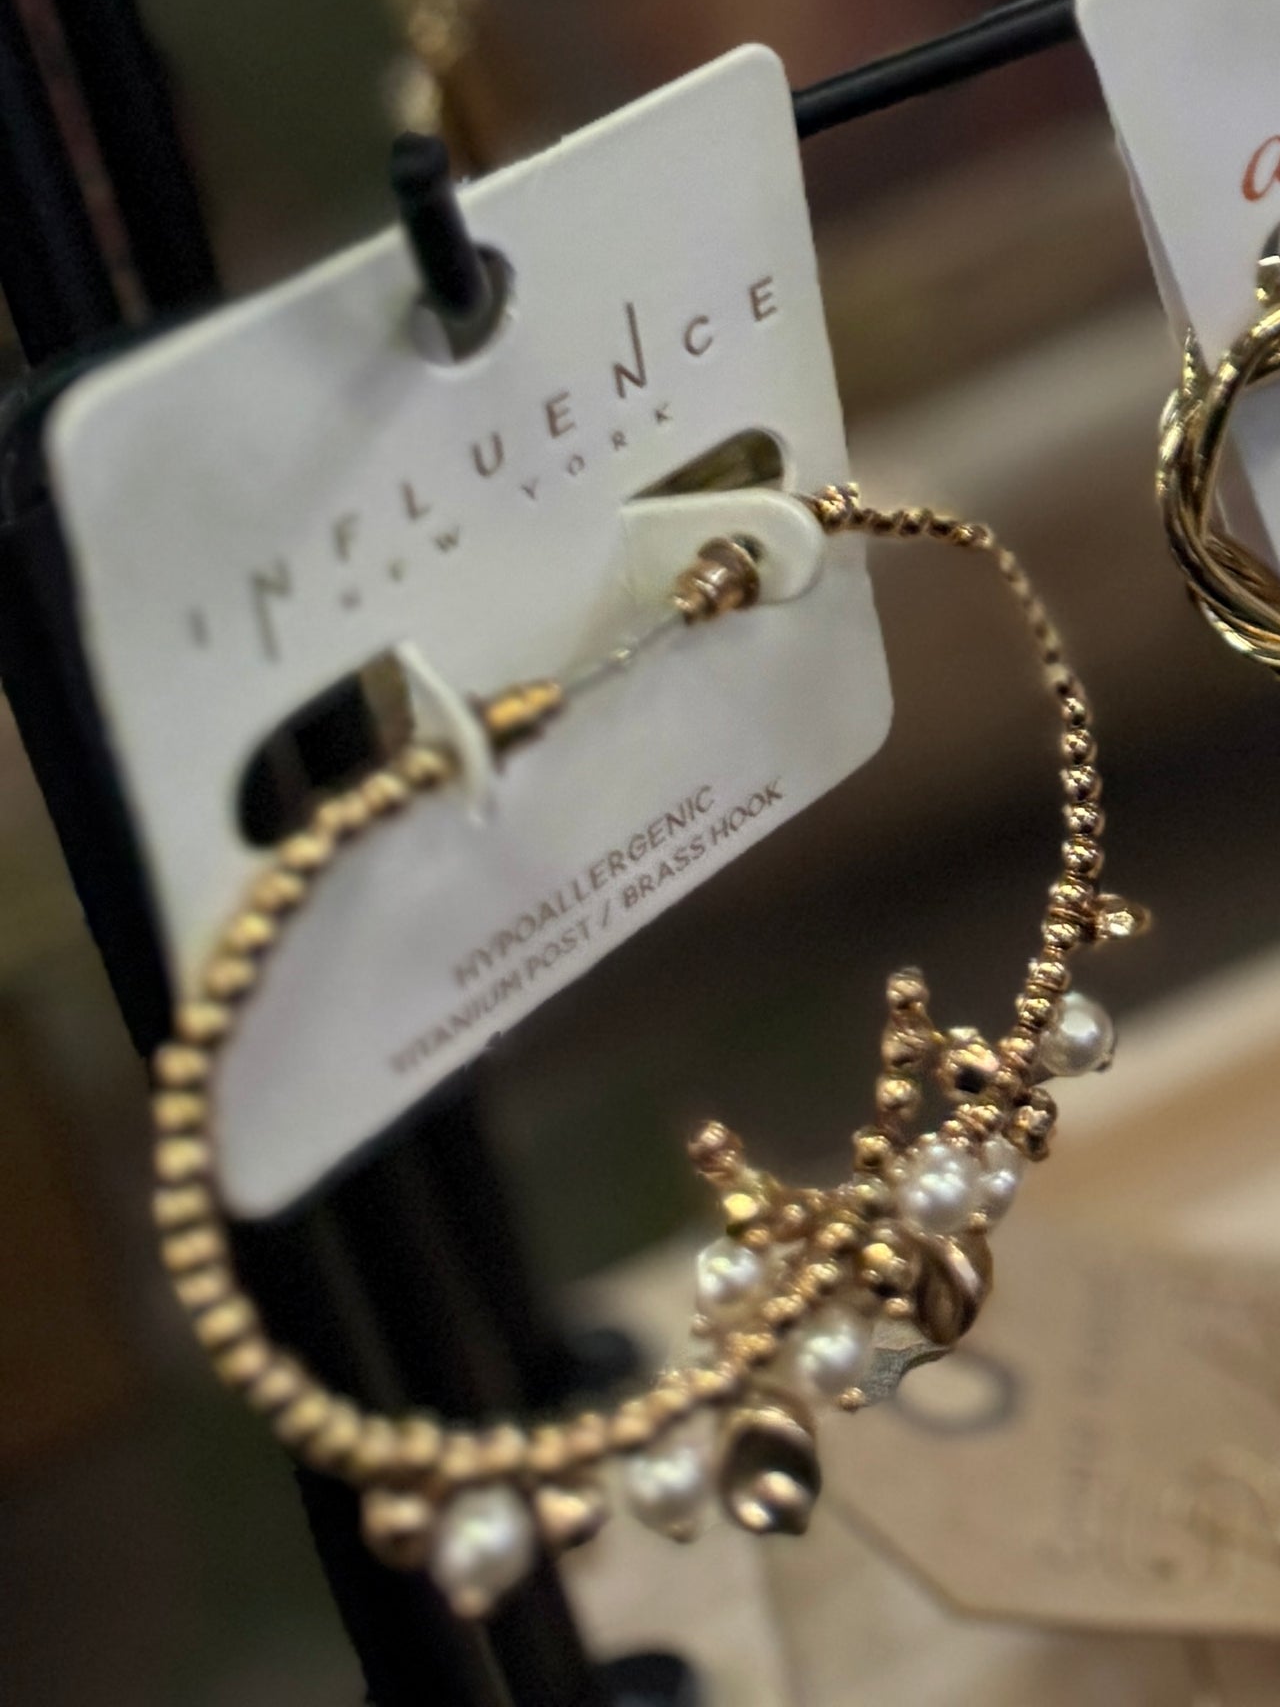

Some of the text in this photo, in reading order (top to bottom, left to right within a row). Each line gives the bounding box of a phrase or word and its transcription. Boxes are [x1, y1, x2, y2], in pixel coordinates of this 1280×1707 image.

[188, 275, 778, 663] INFLUENCE
[519, 401, 672, 501] YORK
[452, 785, 717, 988] HYPOALLERGENIC
[525, 919, 597, 984] POST
[621, 831, 706, 910] BRASS
[710, 775, 784, 847] HOOK
